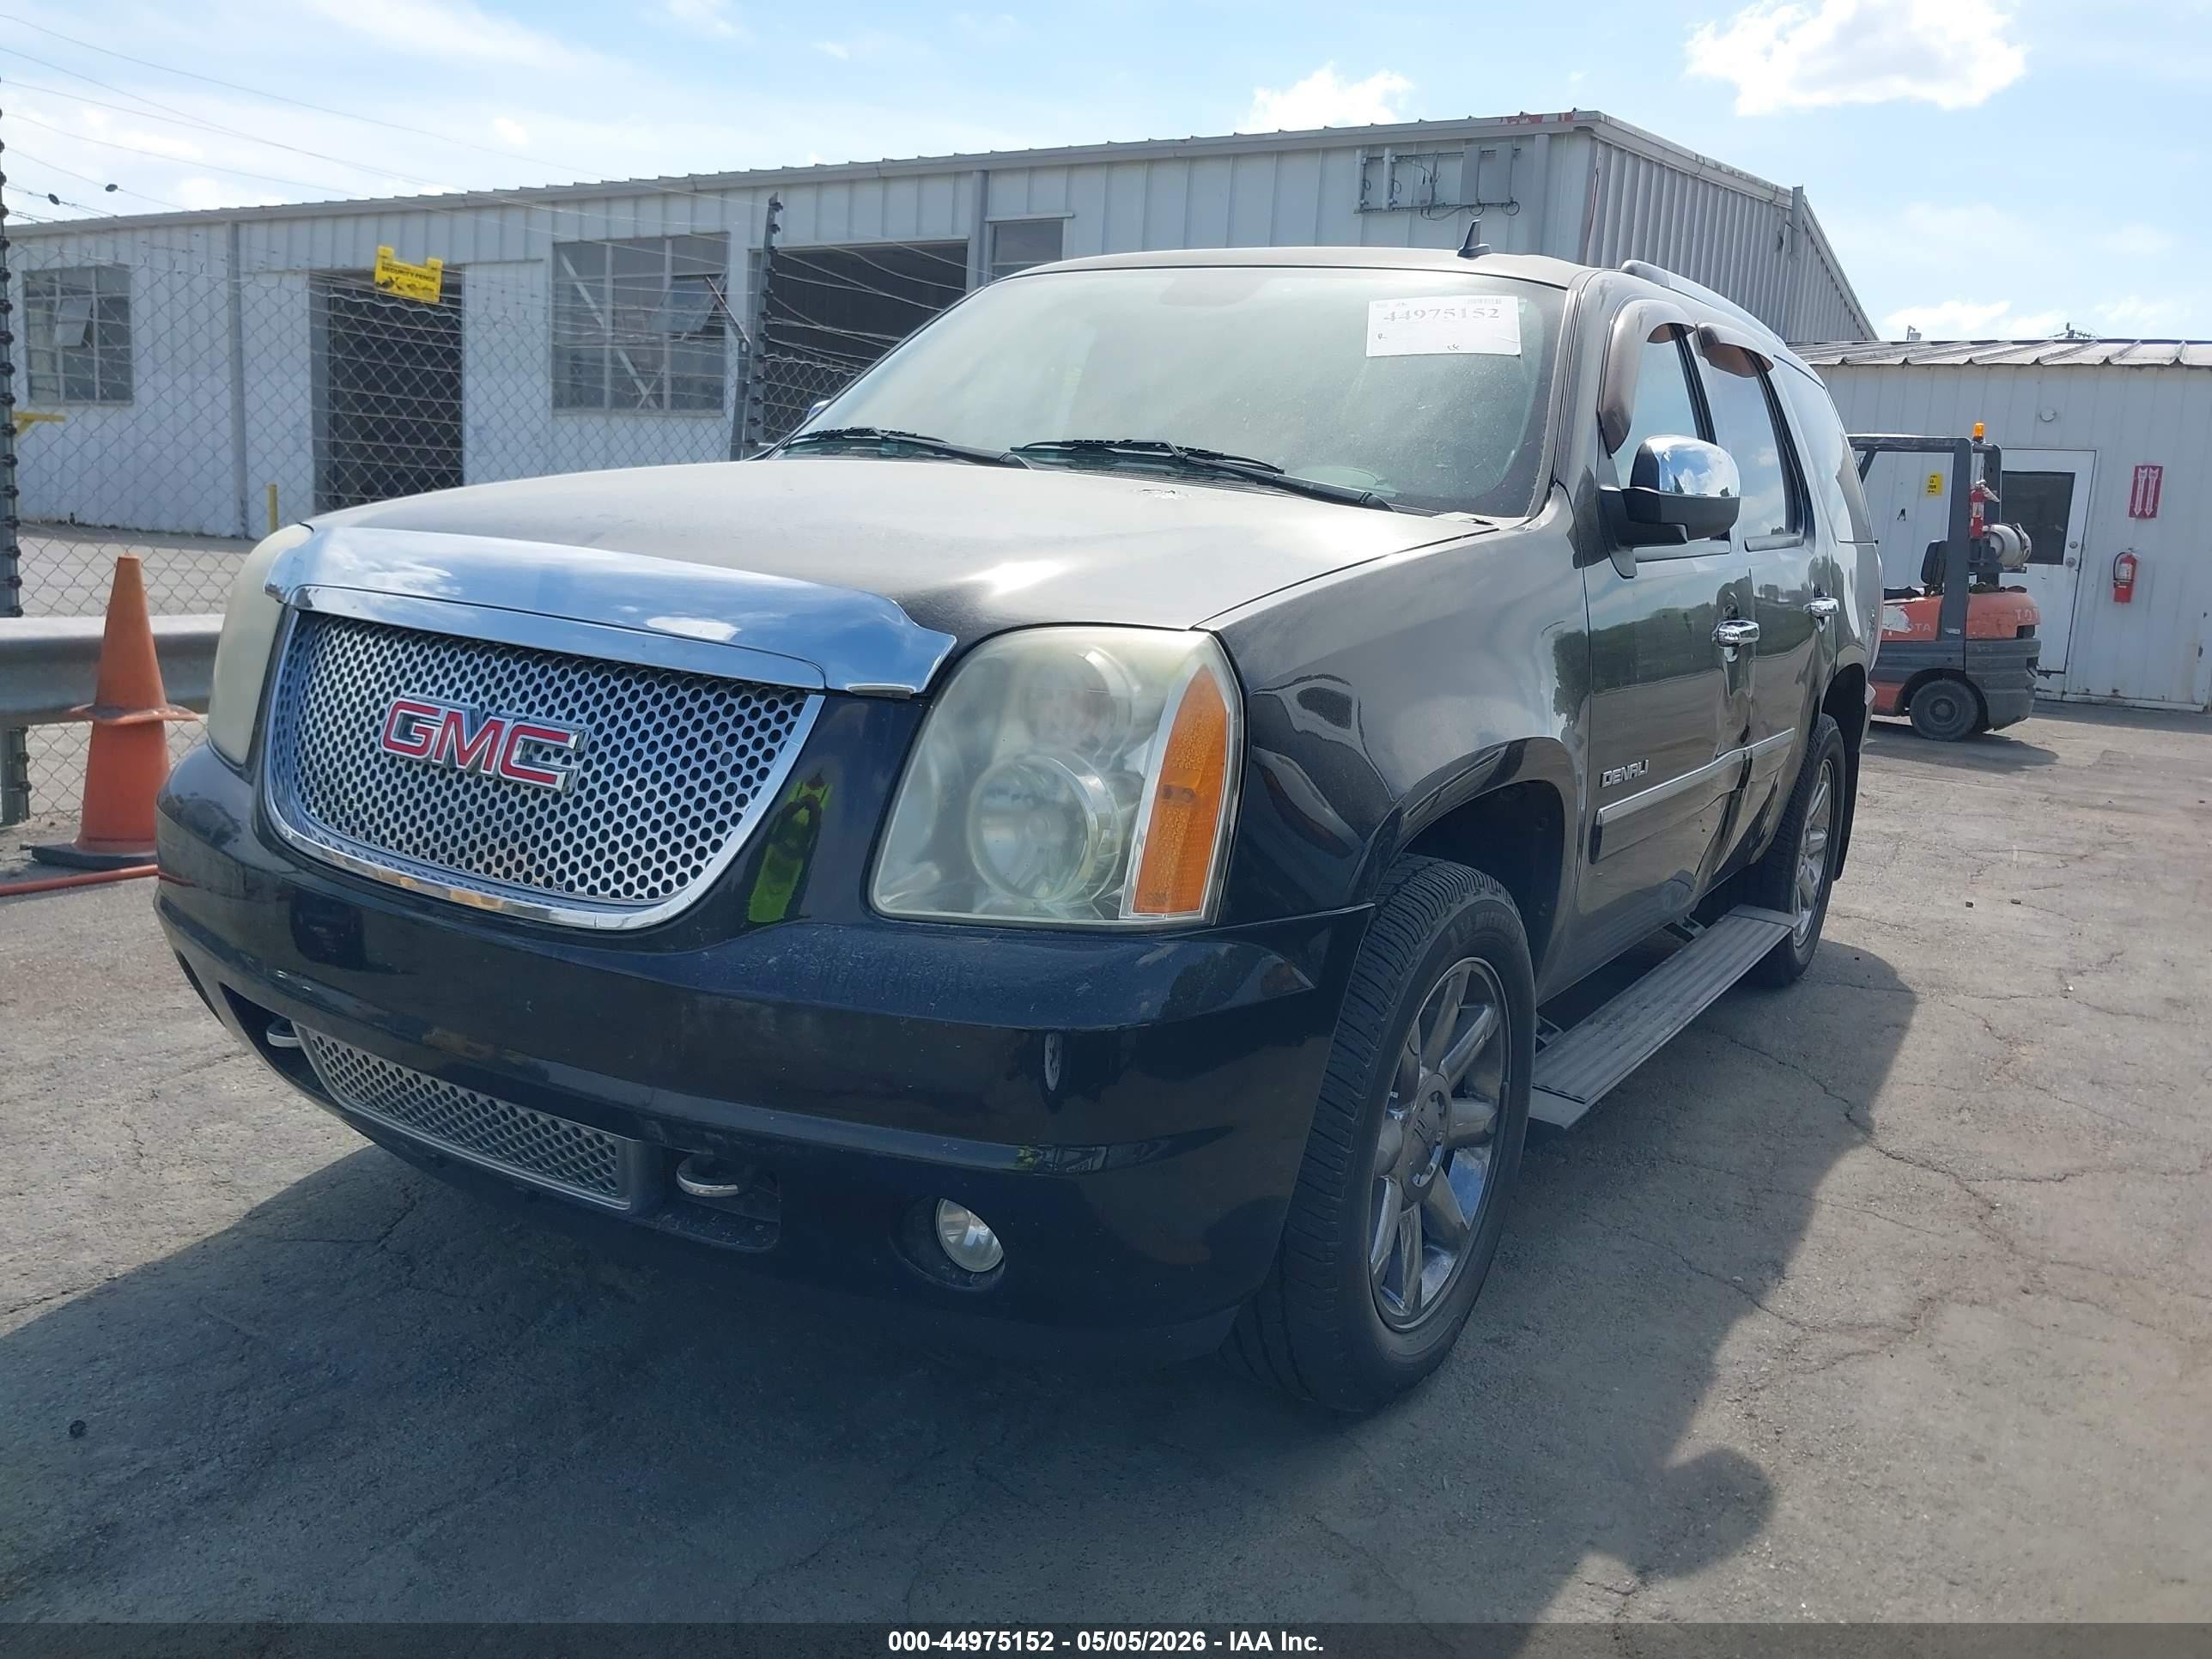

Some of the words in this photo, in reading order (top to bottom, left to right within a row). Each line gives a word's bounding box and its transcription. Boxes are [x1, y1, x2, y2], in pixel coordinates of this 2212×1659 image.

[1382, 307, 1500, 322] 44975152
[381, 696, 588, 793] GMC
[1601, 759, 1650, 787] DENALI
